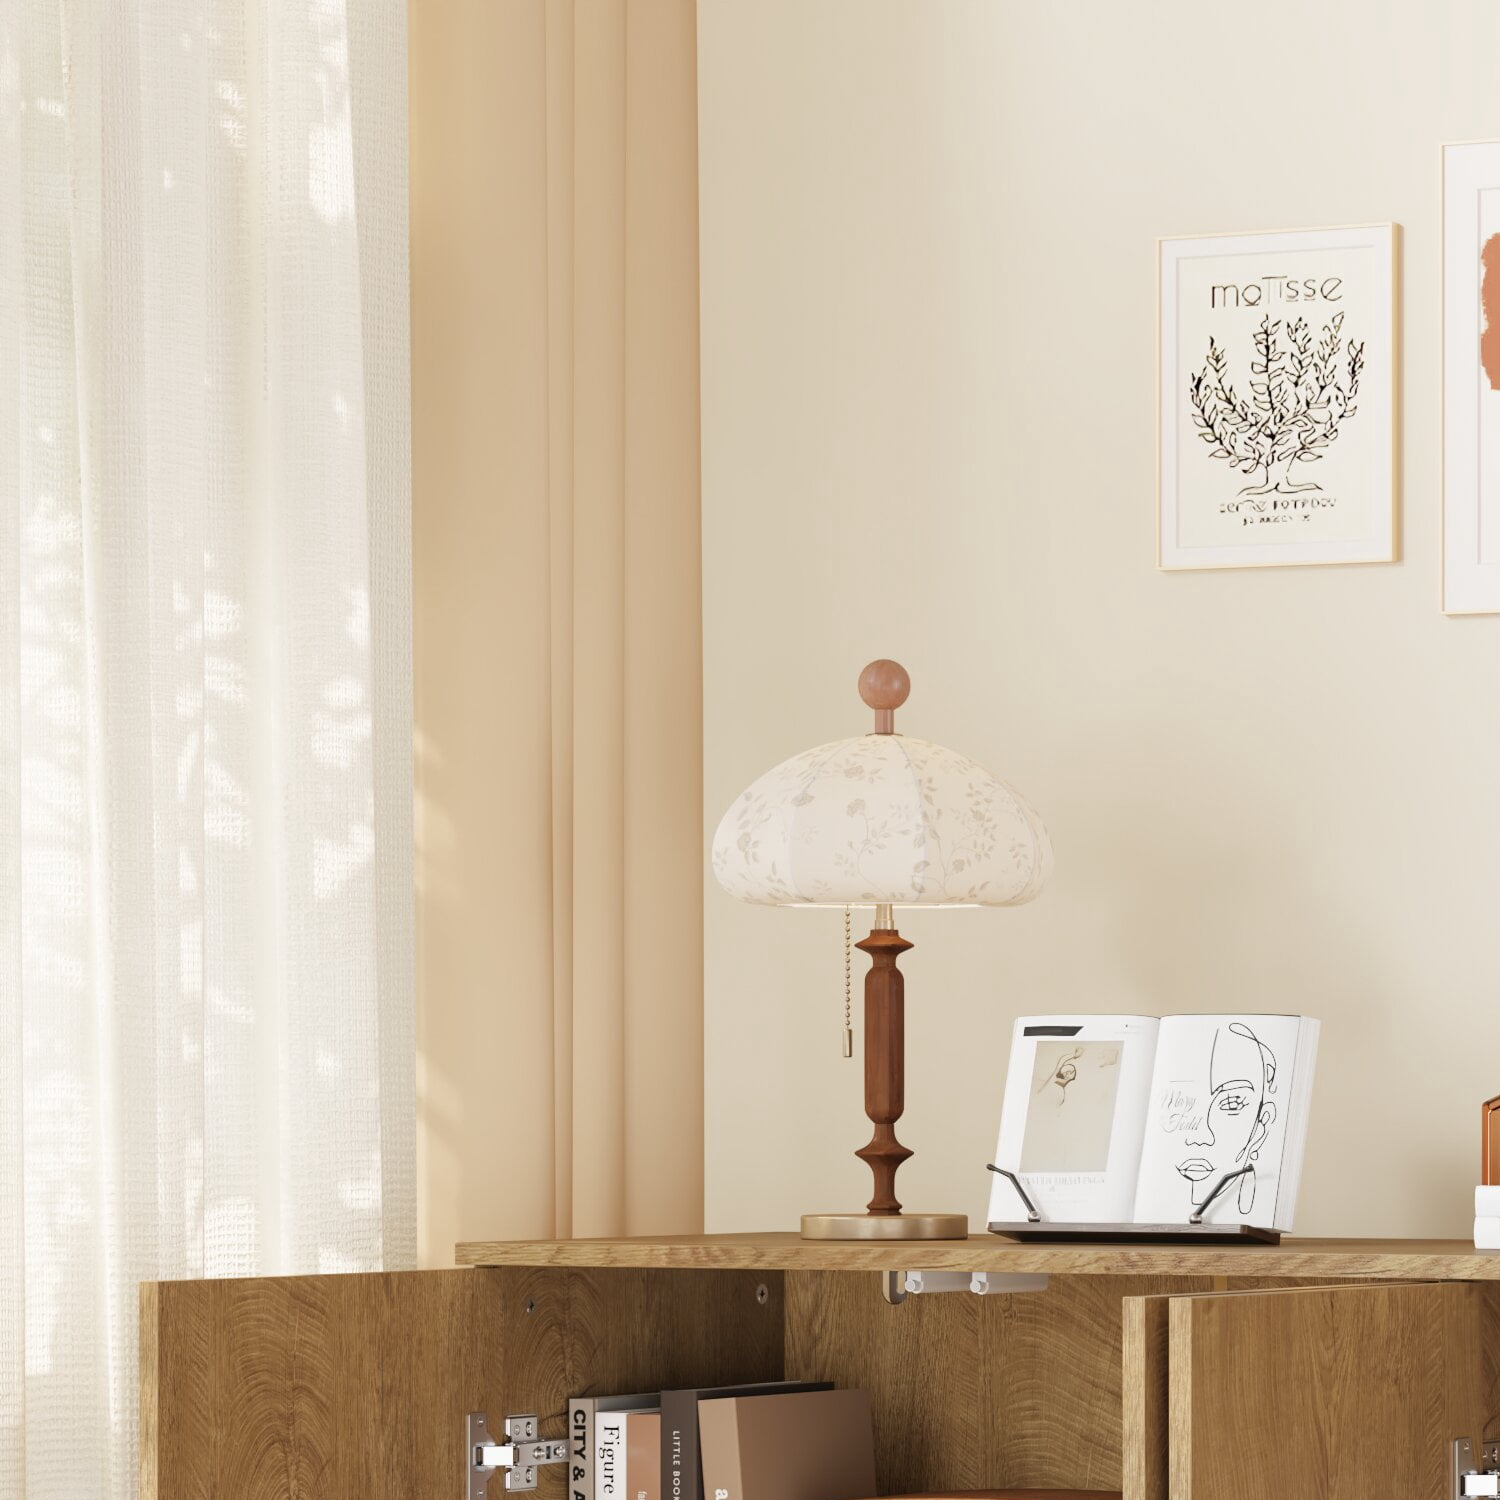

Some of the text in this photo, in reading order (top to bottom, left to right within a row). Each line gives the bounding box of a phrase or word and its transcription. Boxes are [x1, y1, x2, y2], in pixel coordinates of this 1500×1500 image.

[573, 1408, 587, 1460] CITY
[599, 1425, 620, 1494] Figure
[573, 1466, 586, 1481] &
